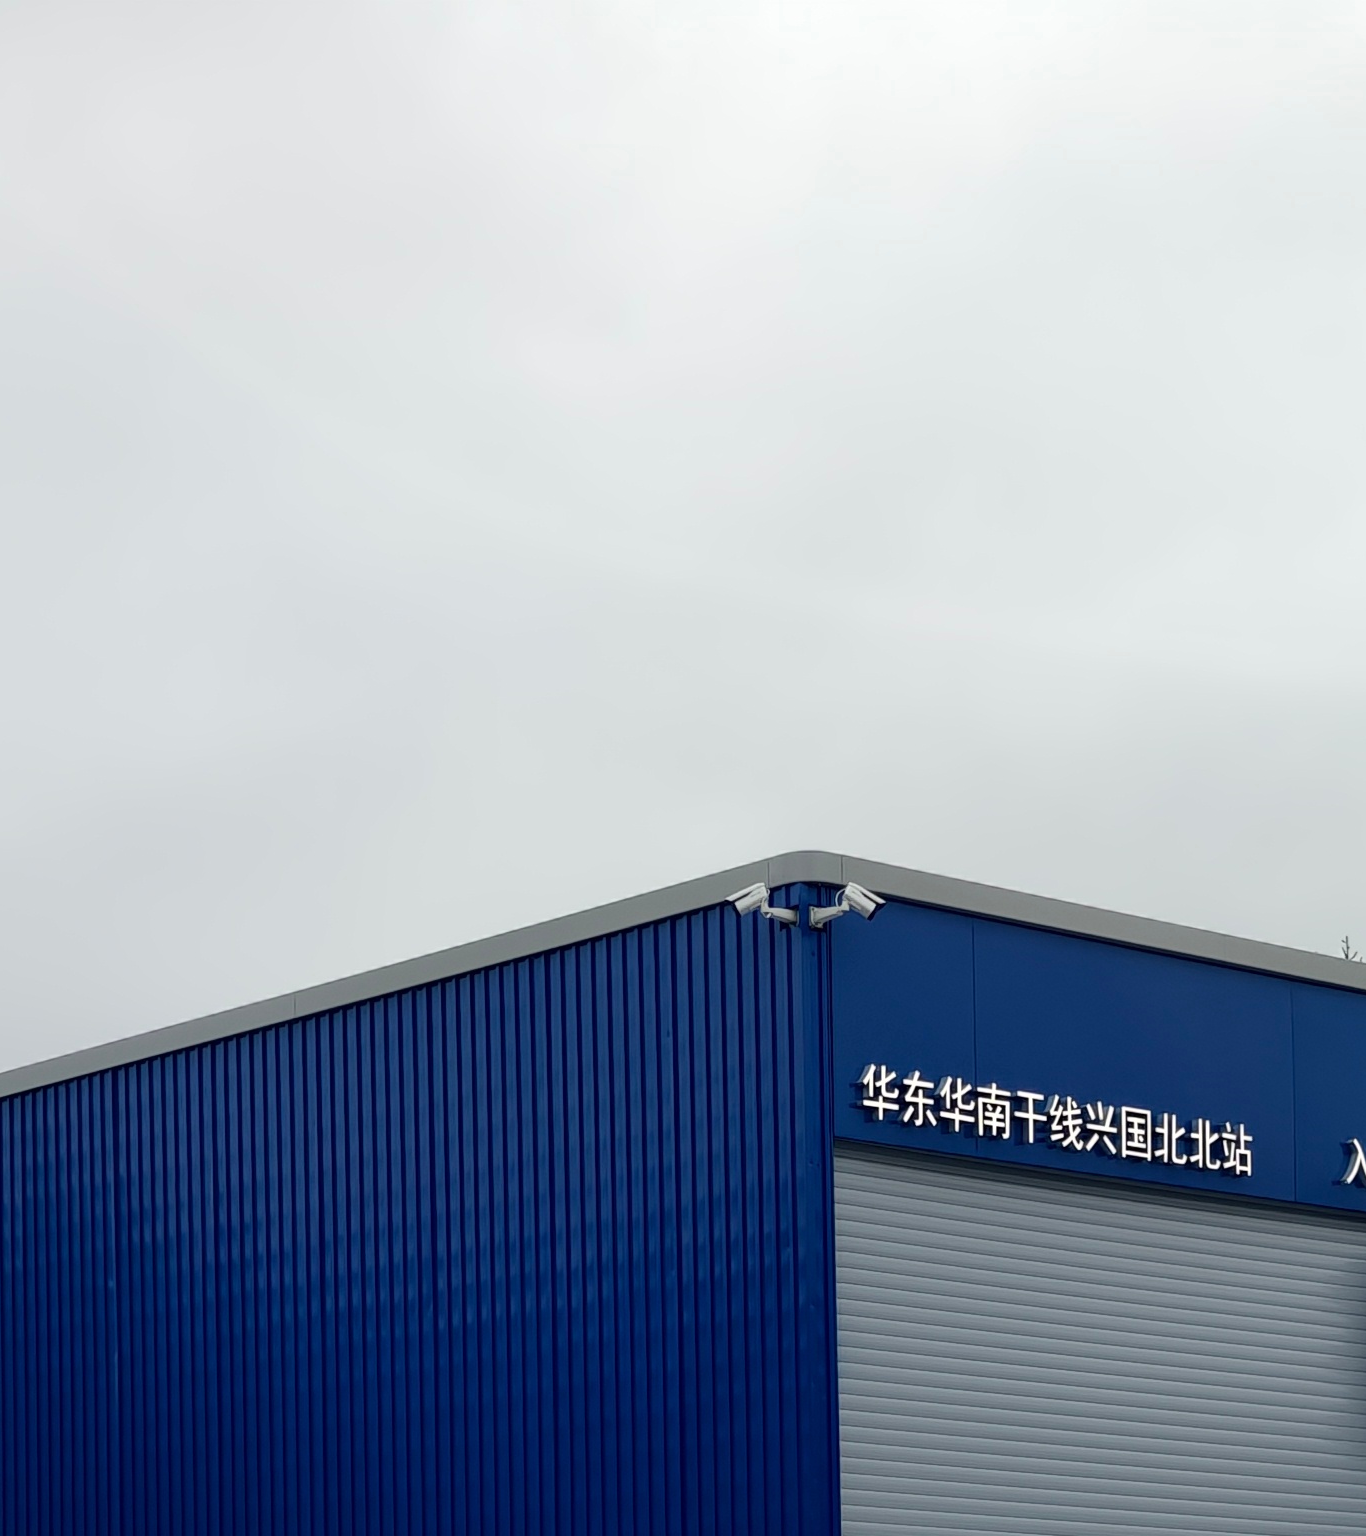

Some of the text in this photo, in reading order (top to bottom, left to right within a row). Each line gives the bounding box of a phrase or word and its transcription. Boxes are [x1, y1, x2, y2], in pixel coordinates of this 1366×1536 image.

[862, 1063, 1253, 1177] 华东华南干线兴国北北站
